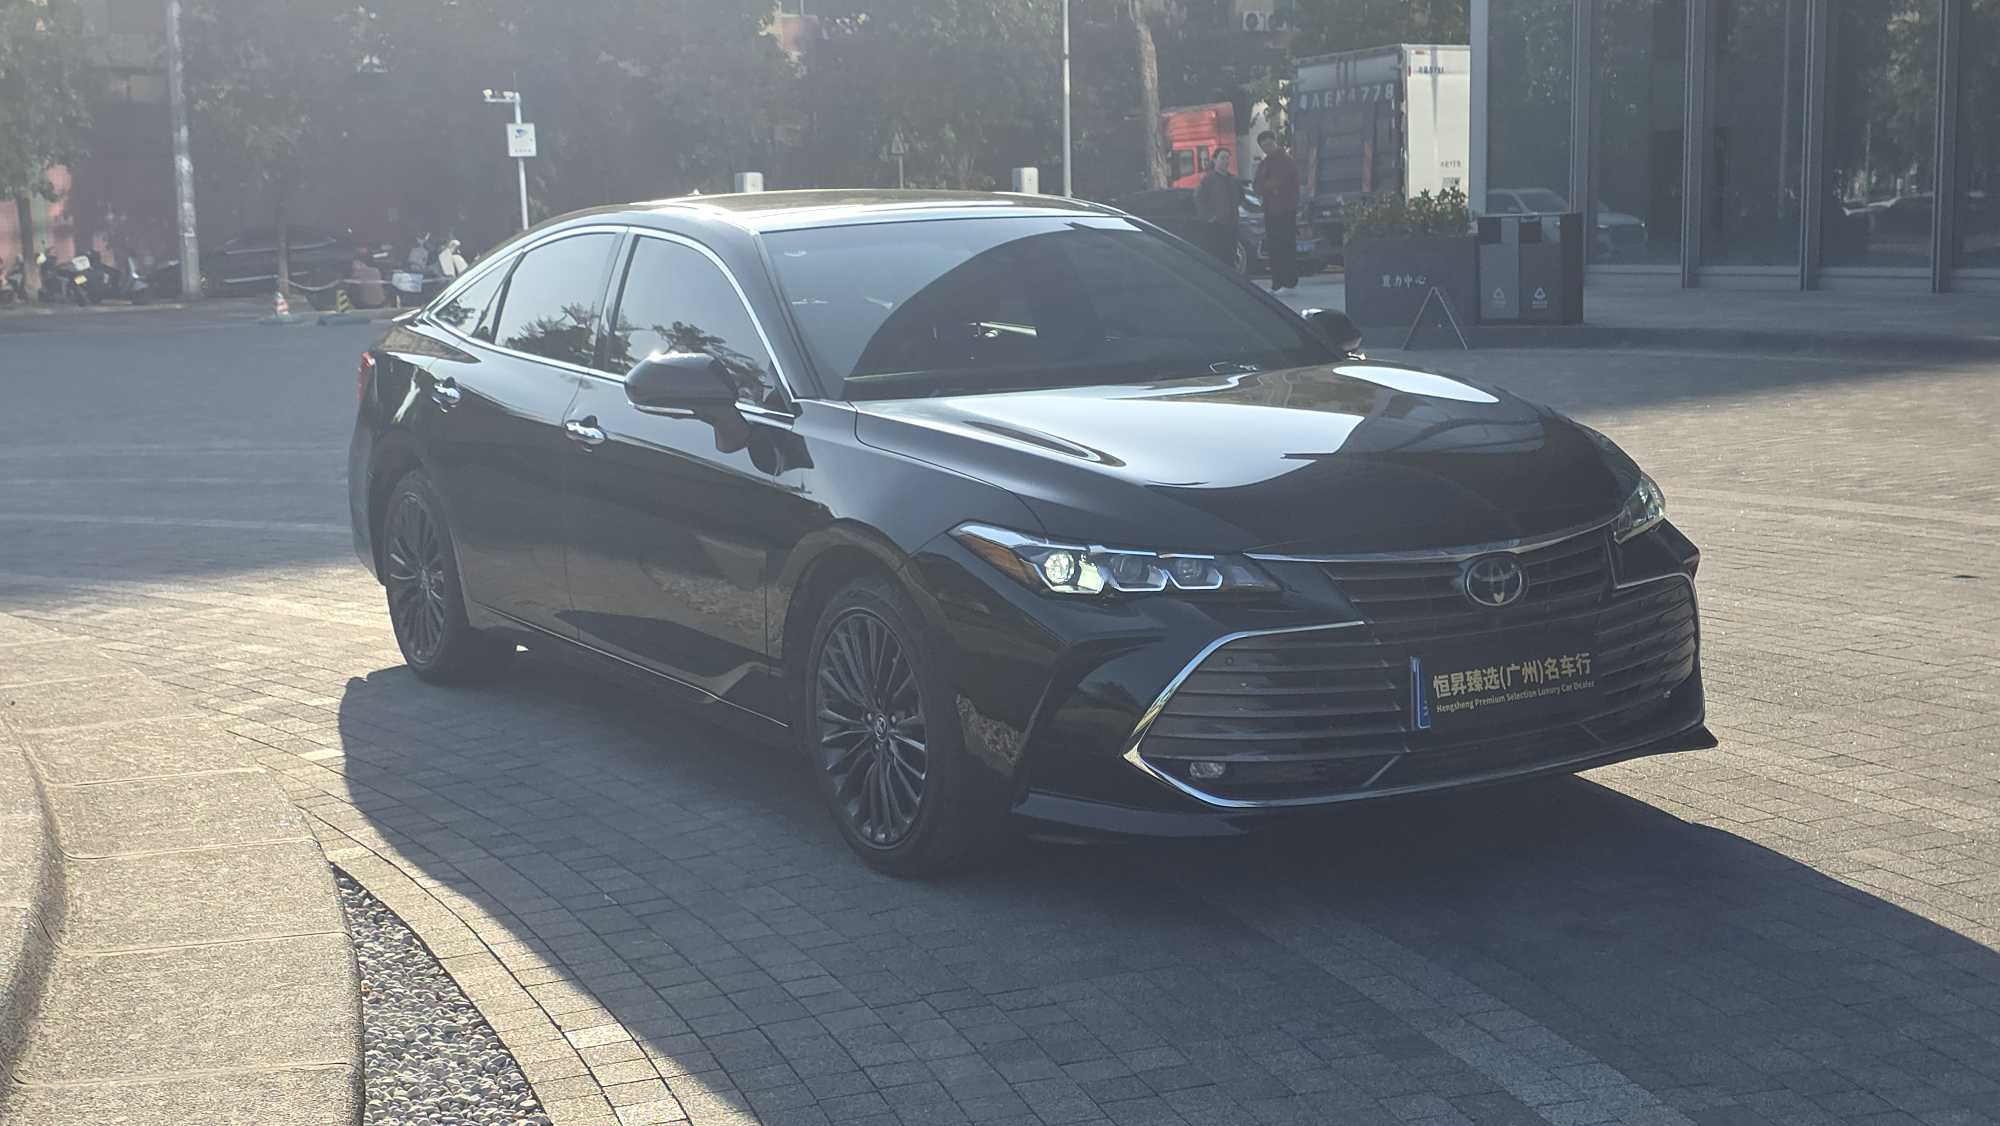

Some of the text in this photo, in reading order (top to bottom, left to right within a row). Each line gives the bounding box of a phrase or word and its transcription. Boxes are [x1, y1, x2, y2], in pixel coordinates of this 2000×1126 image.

[1432, 652, 1592, 699] 恒昇臻选(广州)名车行
[1436, 679, 1596, 713] Hengsheng Premium Selection Luxury Car Dealer
